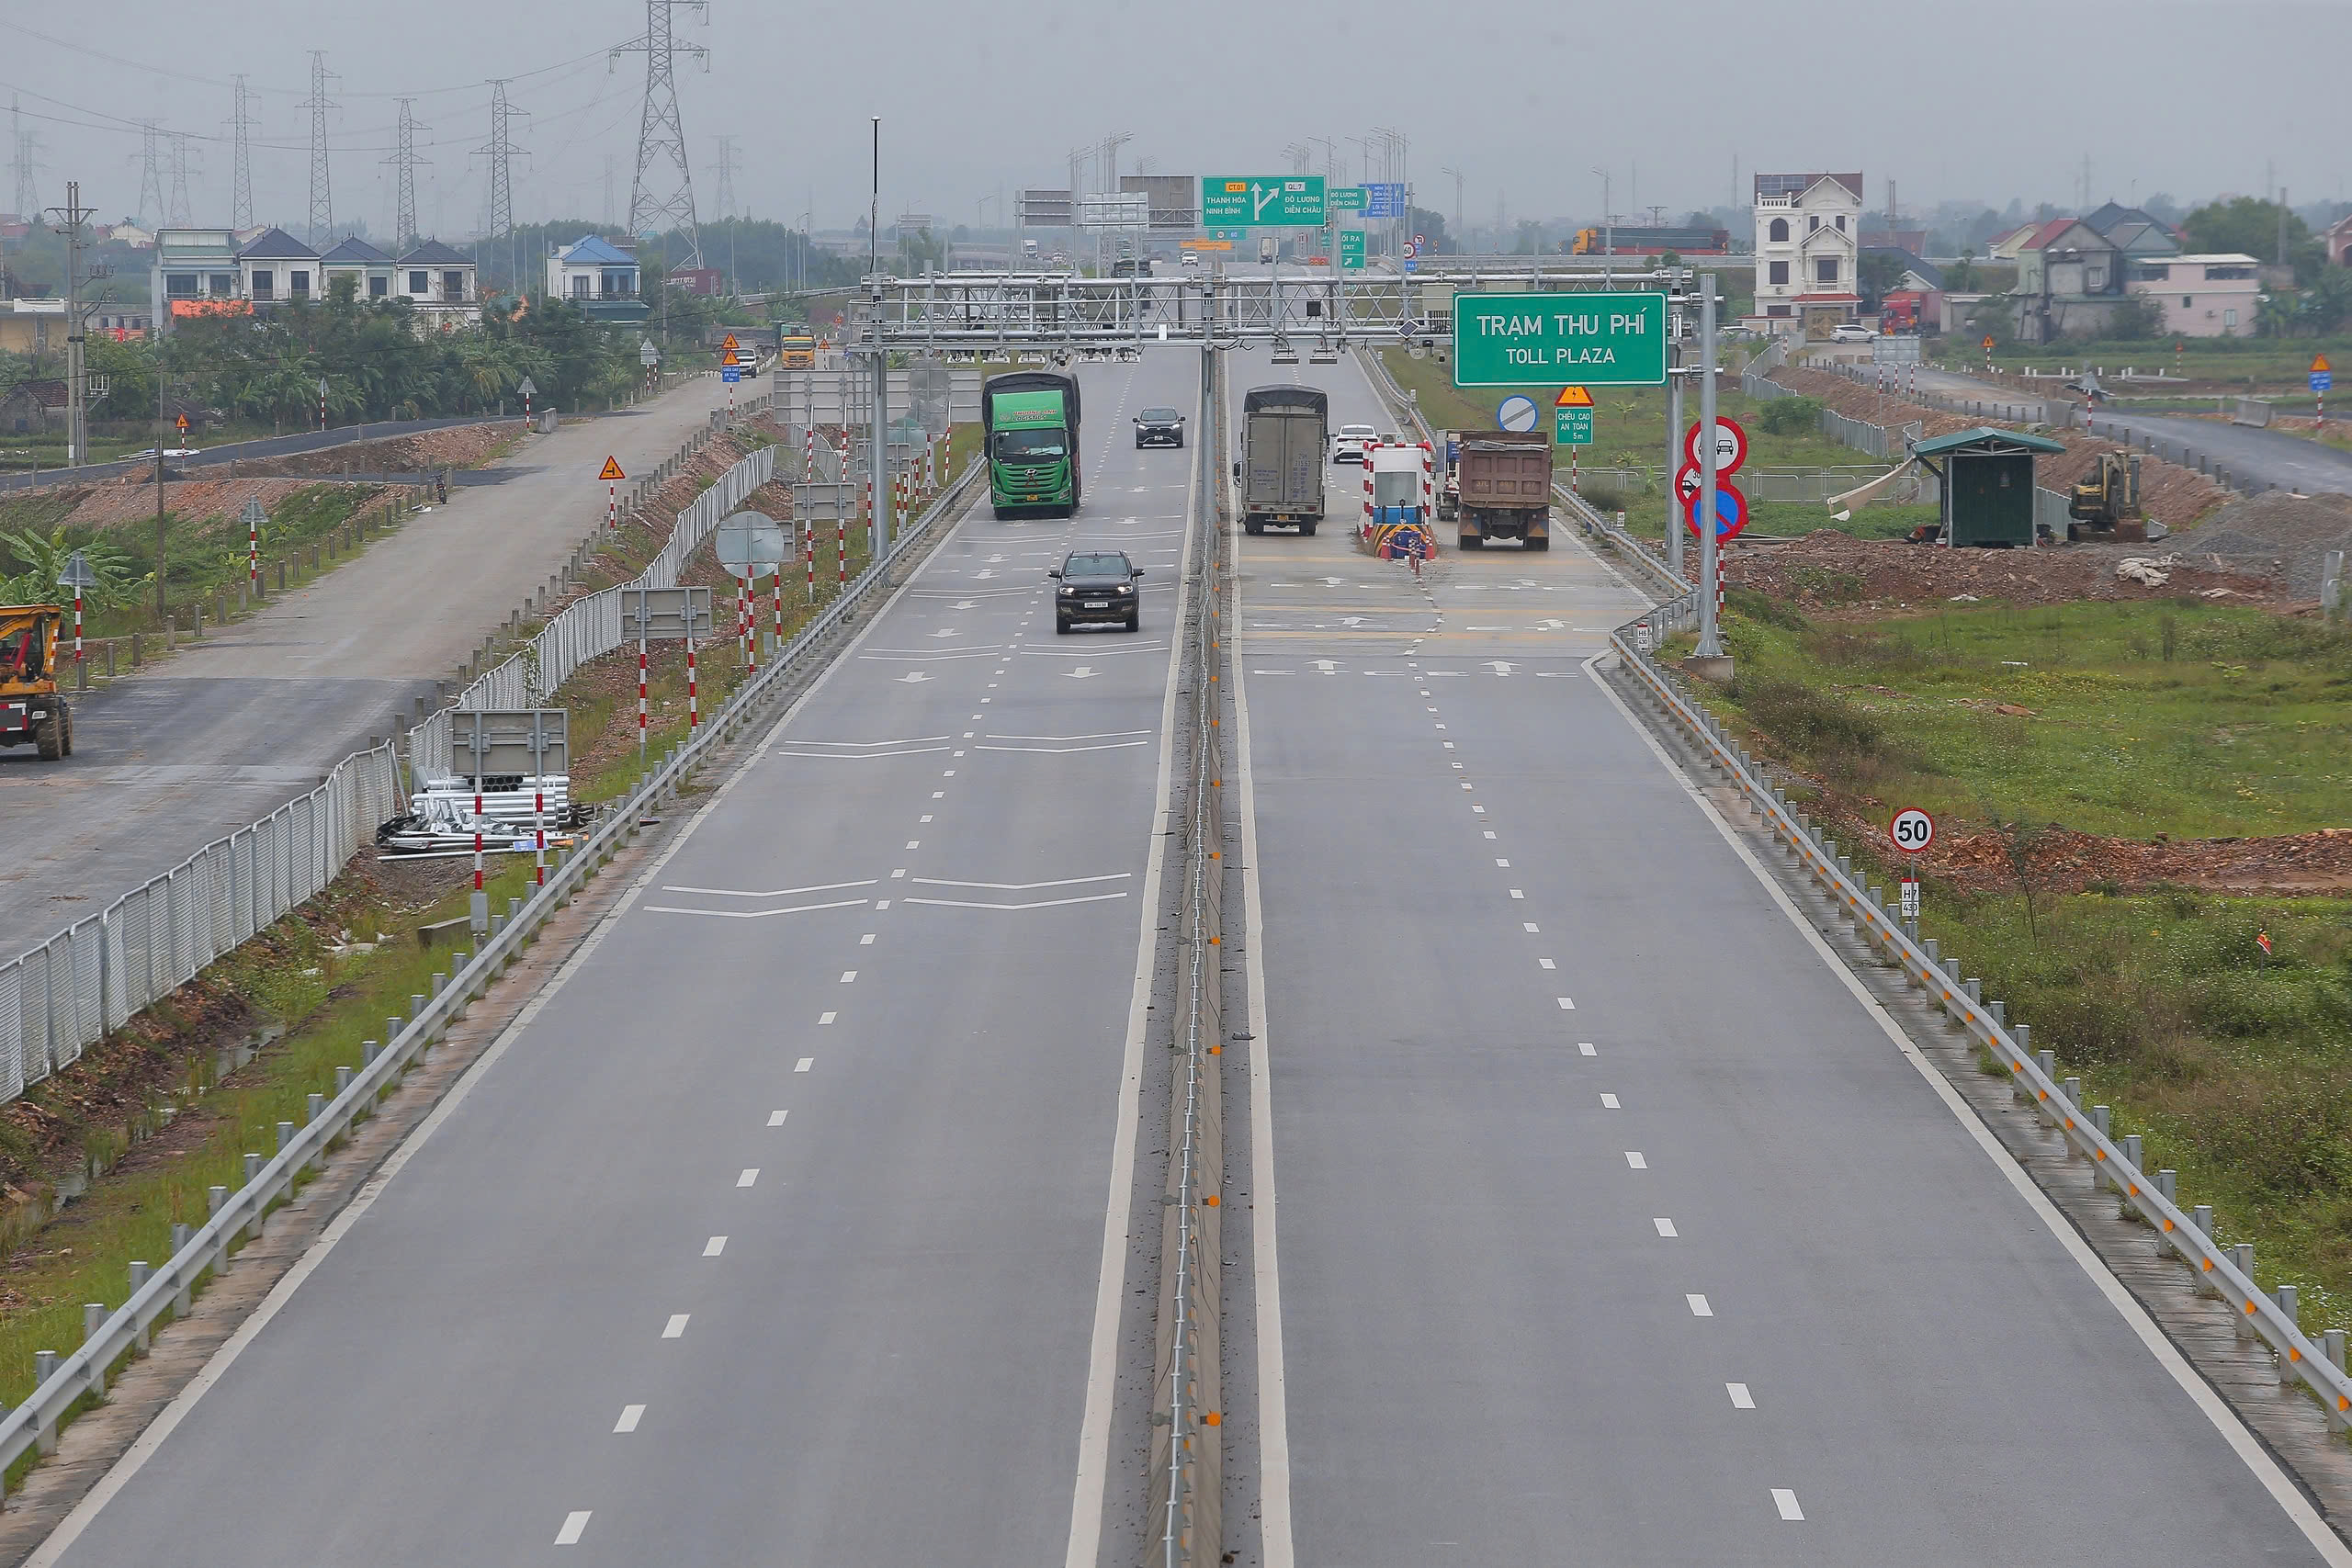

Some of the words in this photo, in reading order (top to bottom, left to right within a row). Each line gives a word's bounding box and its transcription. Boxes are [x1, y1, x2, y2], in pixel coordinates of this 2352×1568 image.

[1231, 195, 1247, 204] HÓA
[1225, 206, 1241, 214] BÌNH
[1404, 246, 1412, 254] 60
[1476, 315, 1543, 341] TRẠM
[1554, 314, 1599, 335] THU
[1610, 307, 1647, 335] PHÍ
[1505, 348, 1549, 365] TOLL
[1556, 347, 1616, 364] PLAZA
[1577, 412, 1590, 421] CAO
[1560, 423, 1570, 431] AN
[1572, 422, 1589, 431] TOÀN
[1897, 819, 1928, 842] 50
